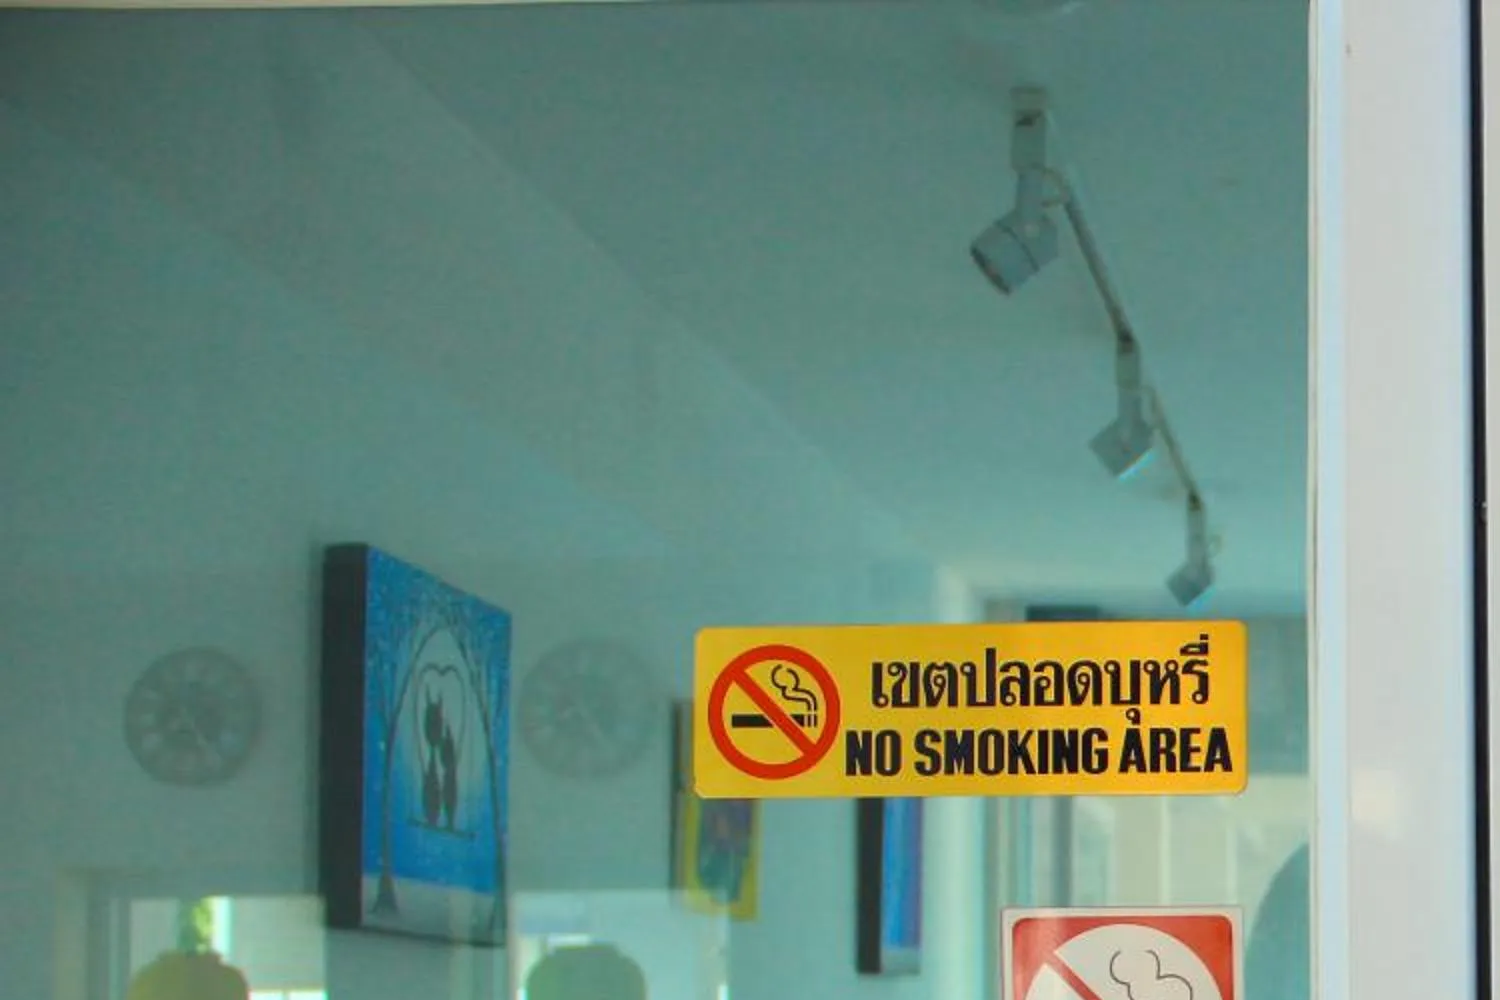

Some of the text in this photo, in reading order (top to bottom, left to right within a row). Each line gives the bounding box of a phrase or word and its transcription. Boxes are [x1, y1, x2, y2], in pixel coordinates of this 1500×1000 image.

[870, 633, 1210, 726] เขตปลอดบุหรี่
[845, 727, 1233, 777] NO SMOKING AREA
